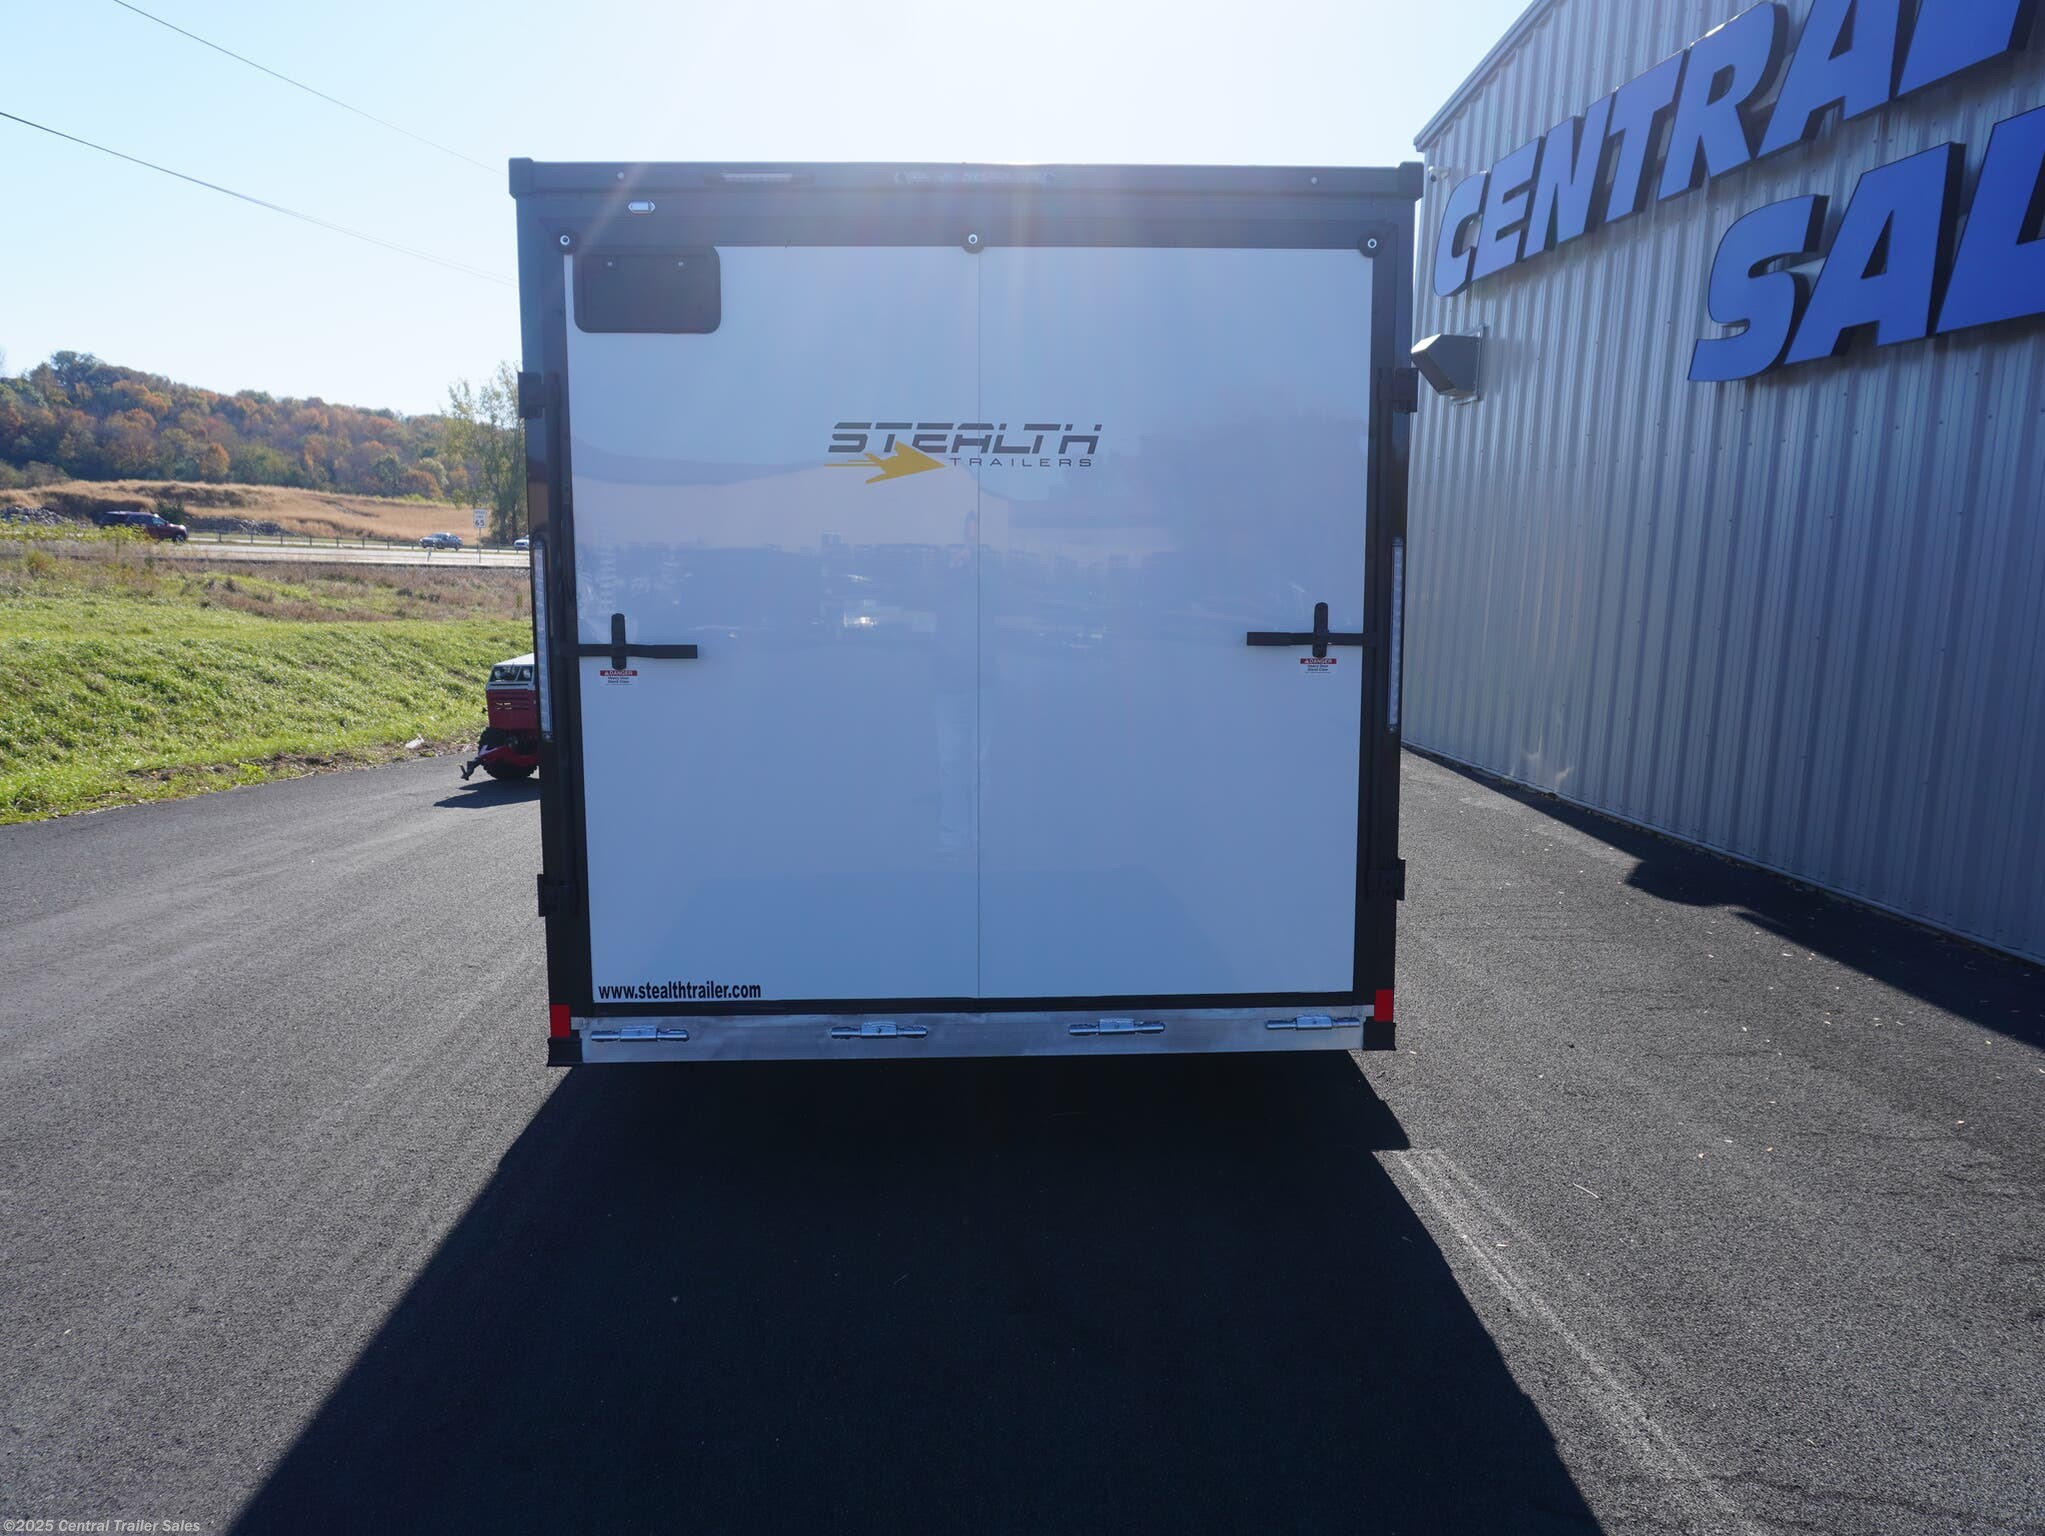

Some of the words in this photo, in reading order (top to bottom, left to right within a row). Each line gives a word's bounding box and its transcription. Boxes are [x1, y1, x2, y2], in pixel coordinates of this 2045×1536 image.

[828, 422, 1102, 454] STEALTH
[949, 457, 1092, 467] TRAILERS
[474, 519, 485, 527] 65
[599, 980, 761, 999] www.stealthtrailer.com
